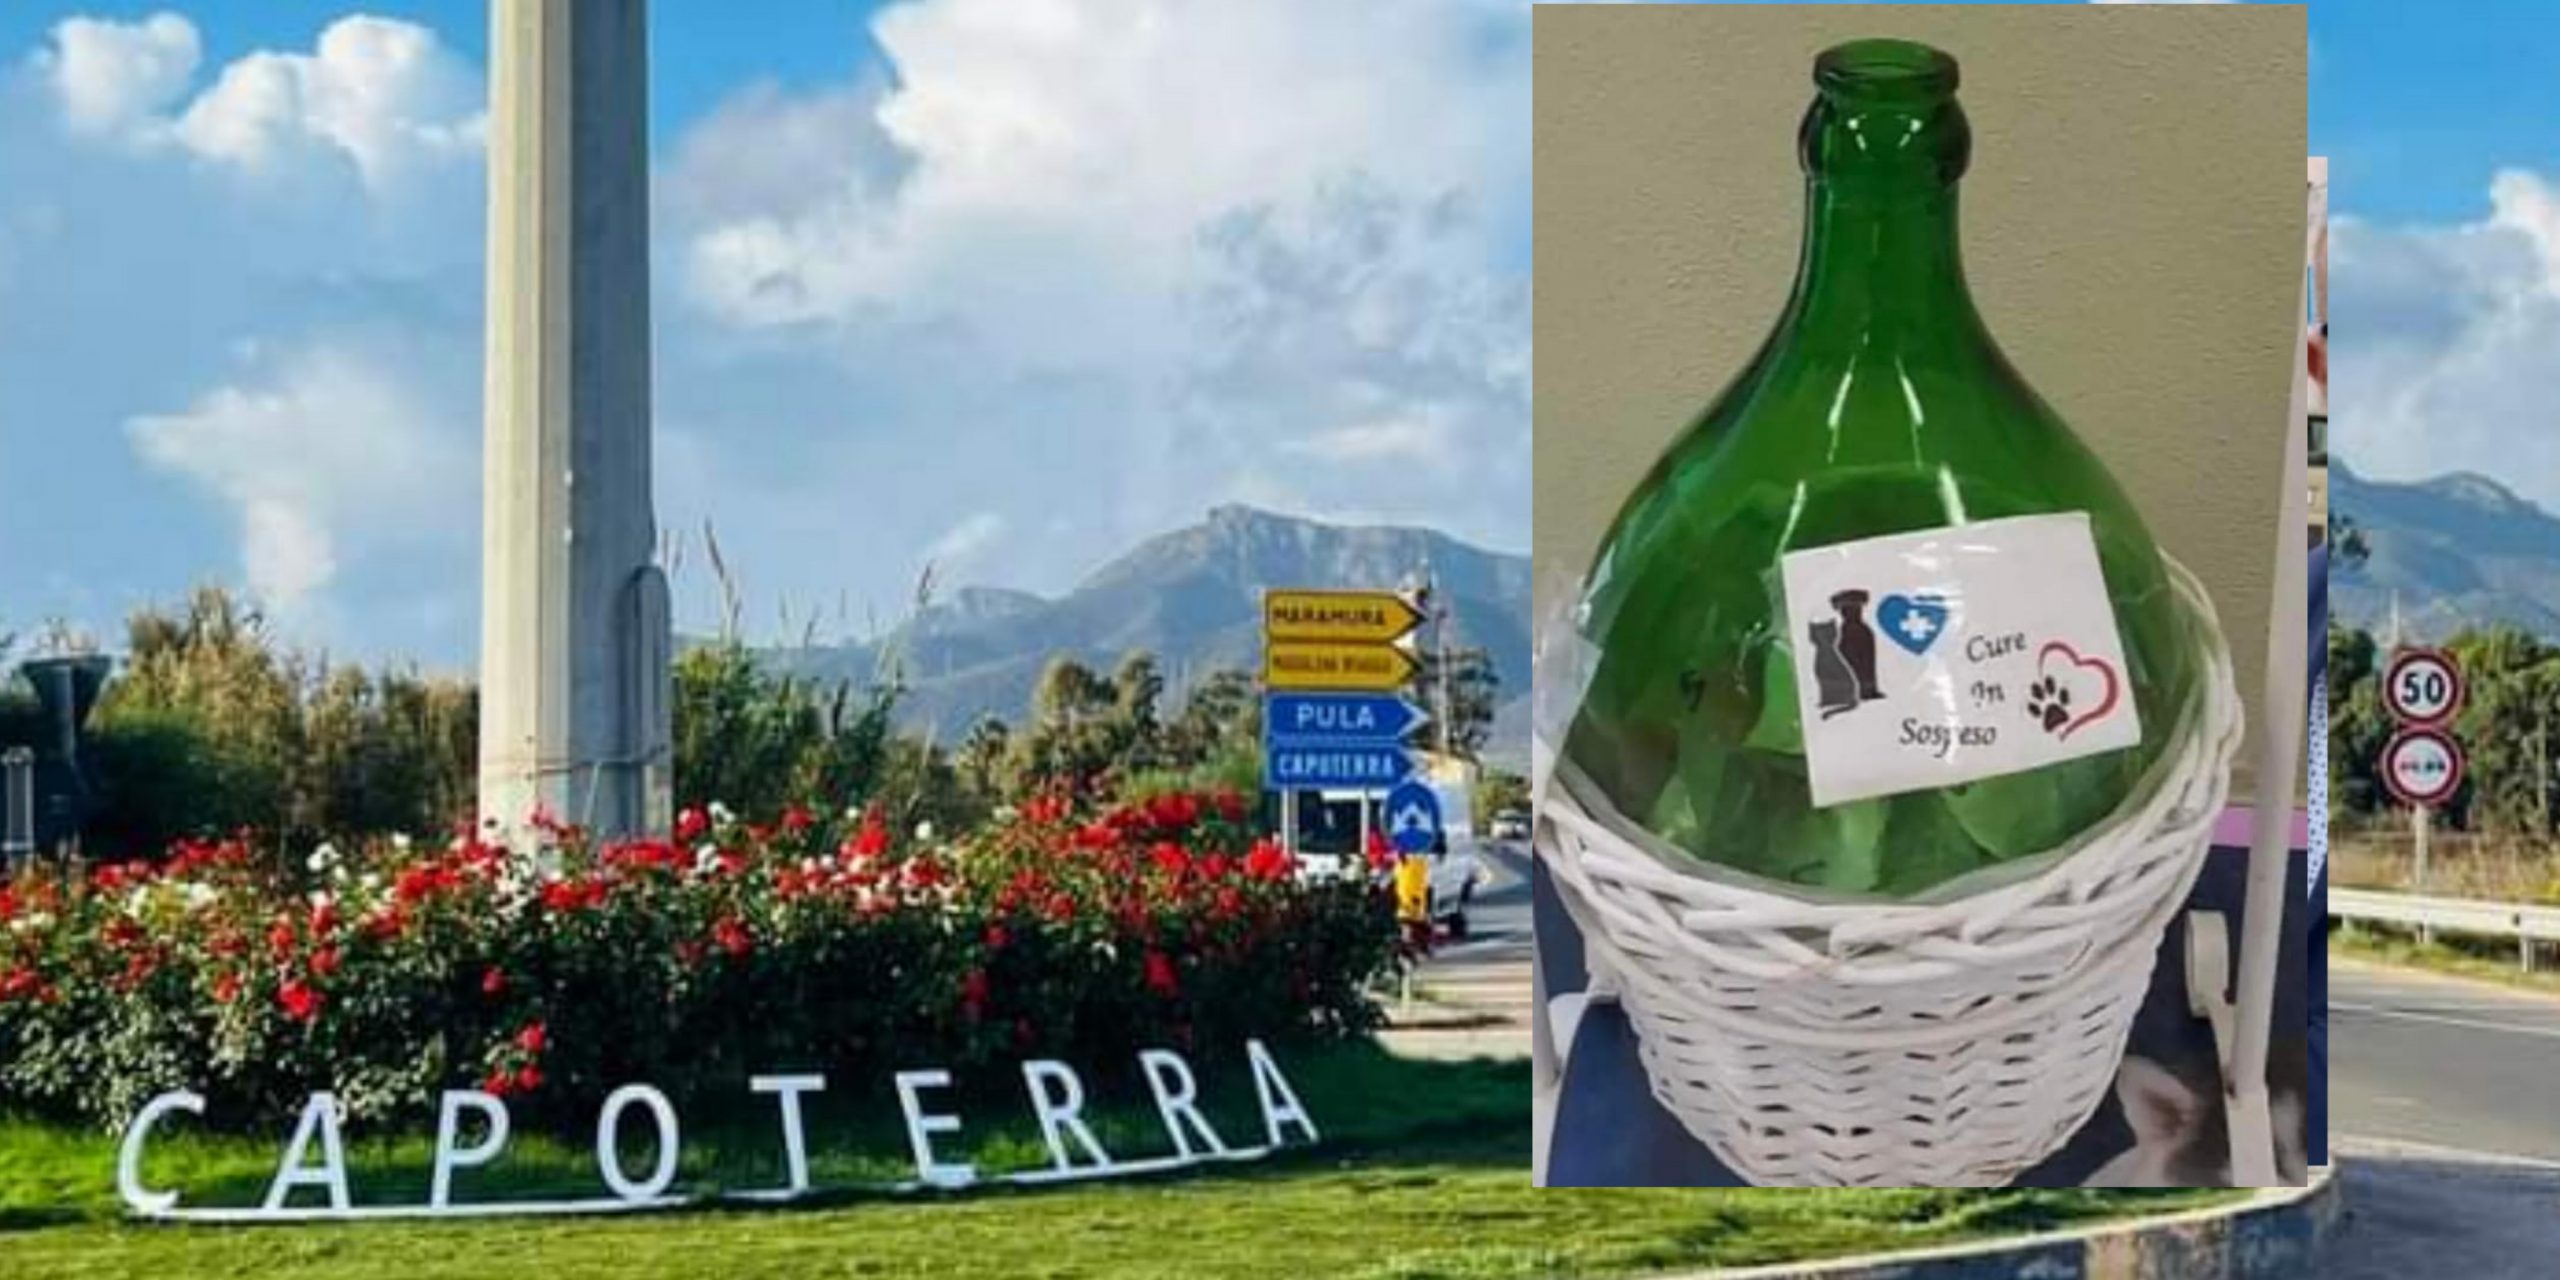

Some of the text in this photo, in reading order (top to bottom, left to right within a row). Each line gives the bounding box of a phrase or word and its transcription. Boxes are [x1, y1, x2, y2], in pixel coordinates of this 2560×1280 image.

[1965, 631, 2027, 663] Cure
[2401, 672, 2446, 705] 50
[1296, 703, 1375, 730] PULA
[1278, 752, 1395, 778] CAPOTERRA
[115, 1037, 1320, 1214] CAPOTERRA
